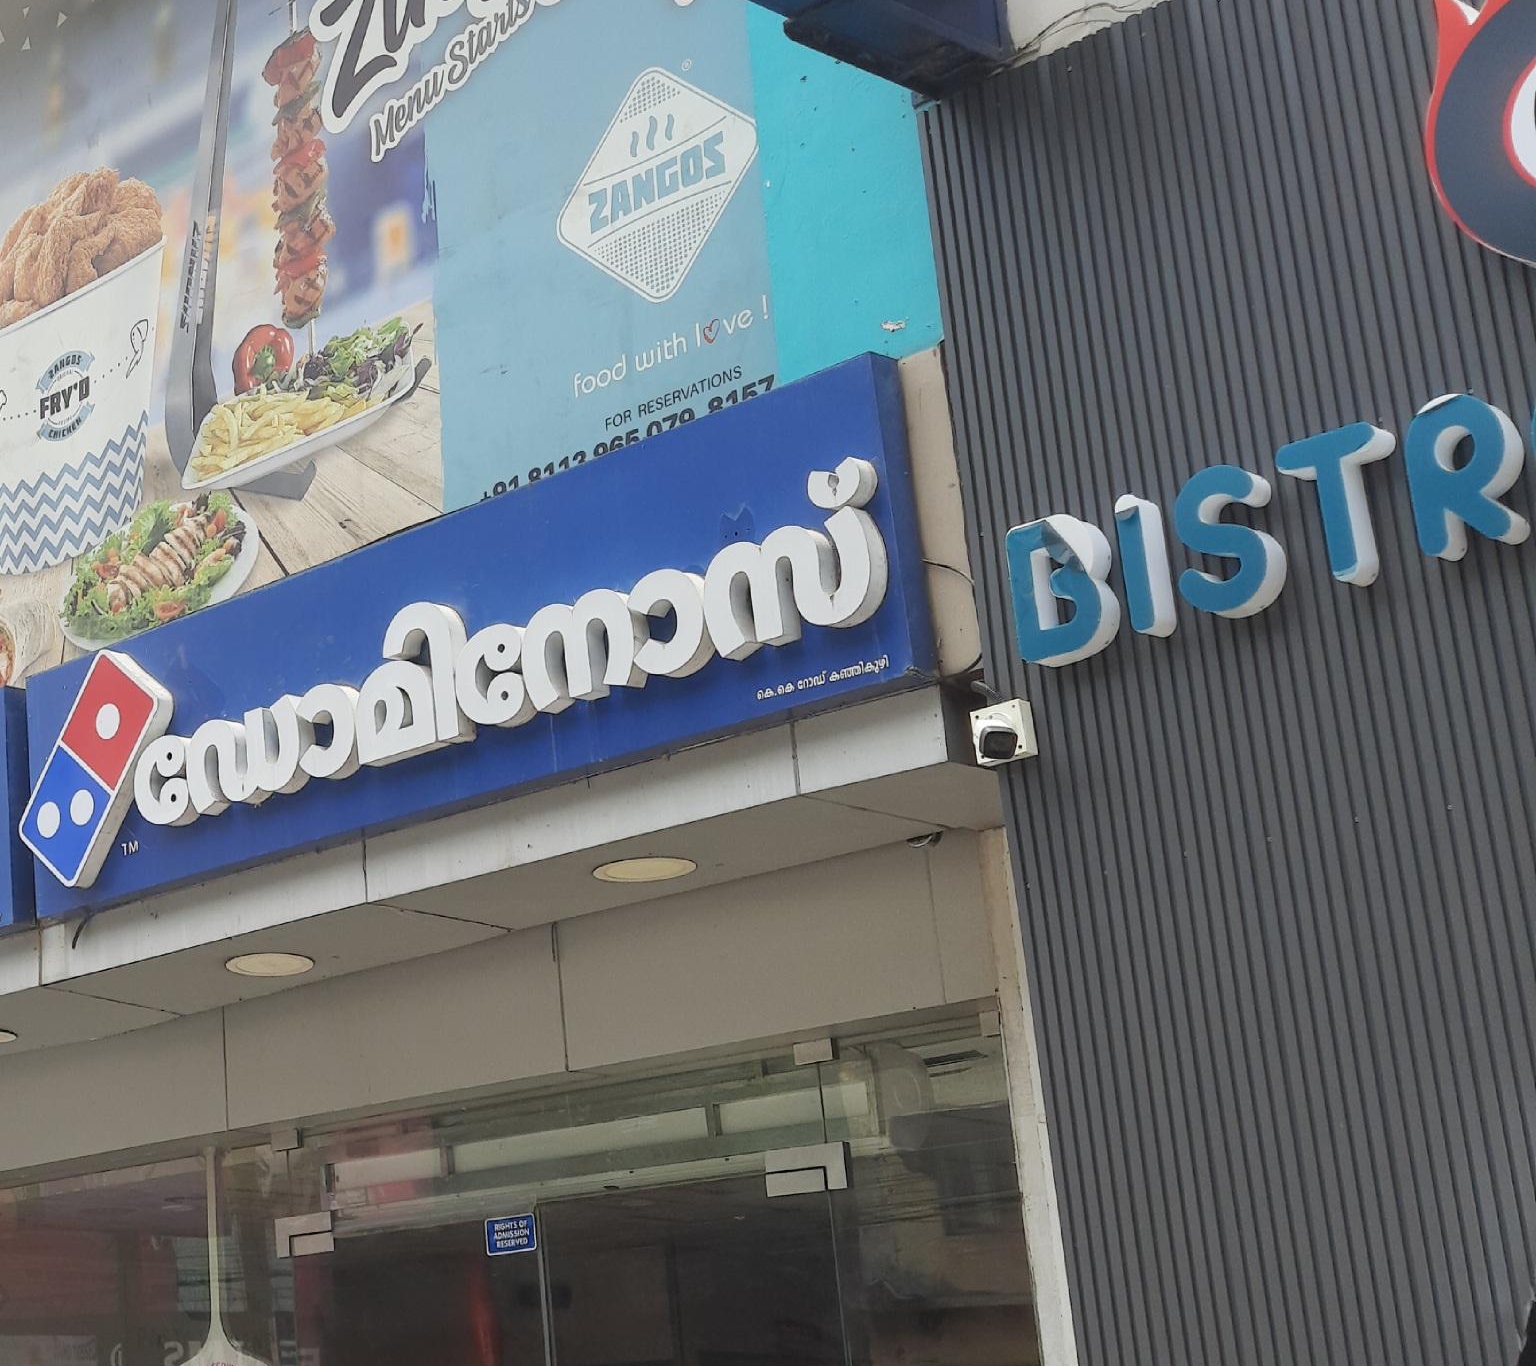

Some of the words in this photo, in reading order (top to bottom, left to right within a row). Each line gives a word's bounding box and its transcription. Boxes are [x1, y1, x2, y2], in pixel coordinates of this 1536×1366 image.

[371, 68, 445, 158] Menu
[588, 130, 726, 235] ZANGOS
[39, 375, 90, 420] FRY'D
[572, 353, 628, 399] food
[634, 331, 688, 373] with
[605, 409, 633, 432] FOR
[637, 365, 743, 418] RESERVATIONS
[1005, 392, 1536, 668] BISTR
[133, 456, 888, 827] ഡോമിനോസ്
[494, 1221, 518, 1232] RIGHTS
[518, 1219, 528, 1228] OF
[494, 1227, 530, 1241] ADMISSION
[496, 1237, 528, 1249] RESERVED
